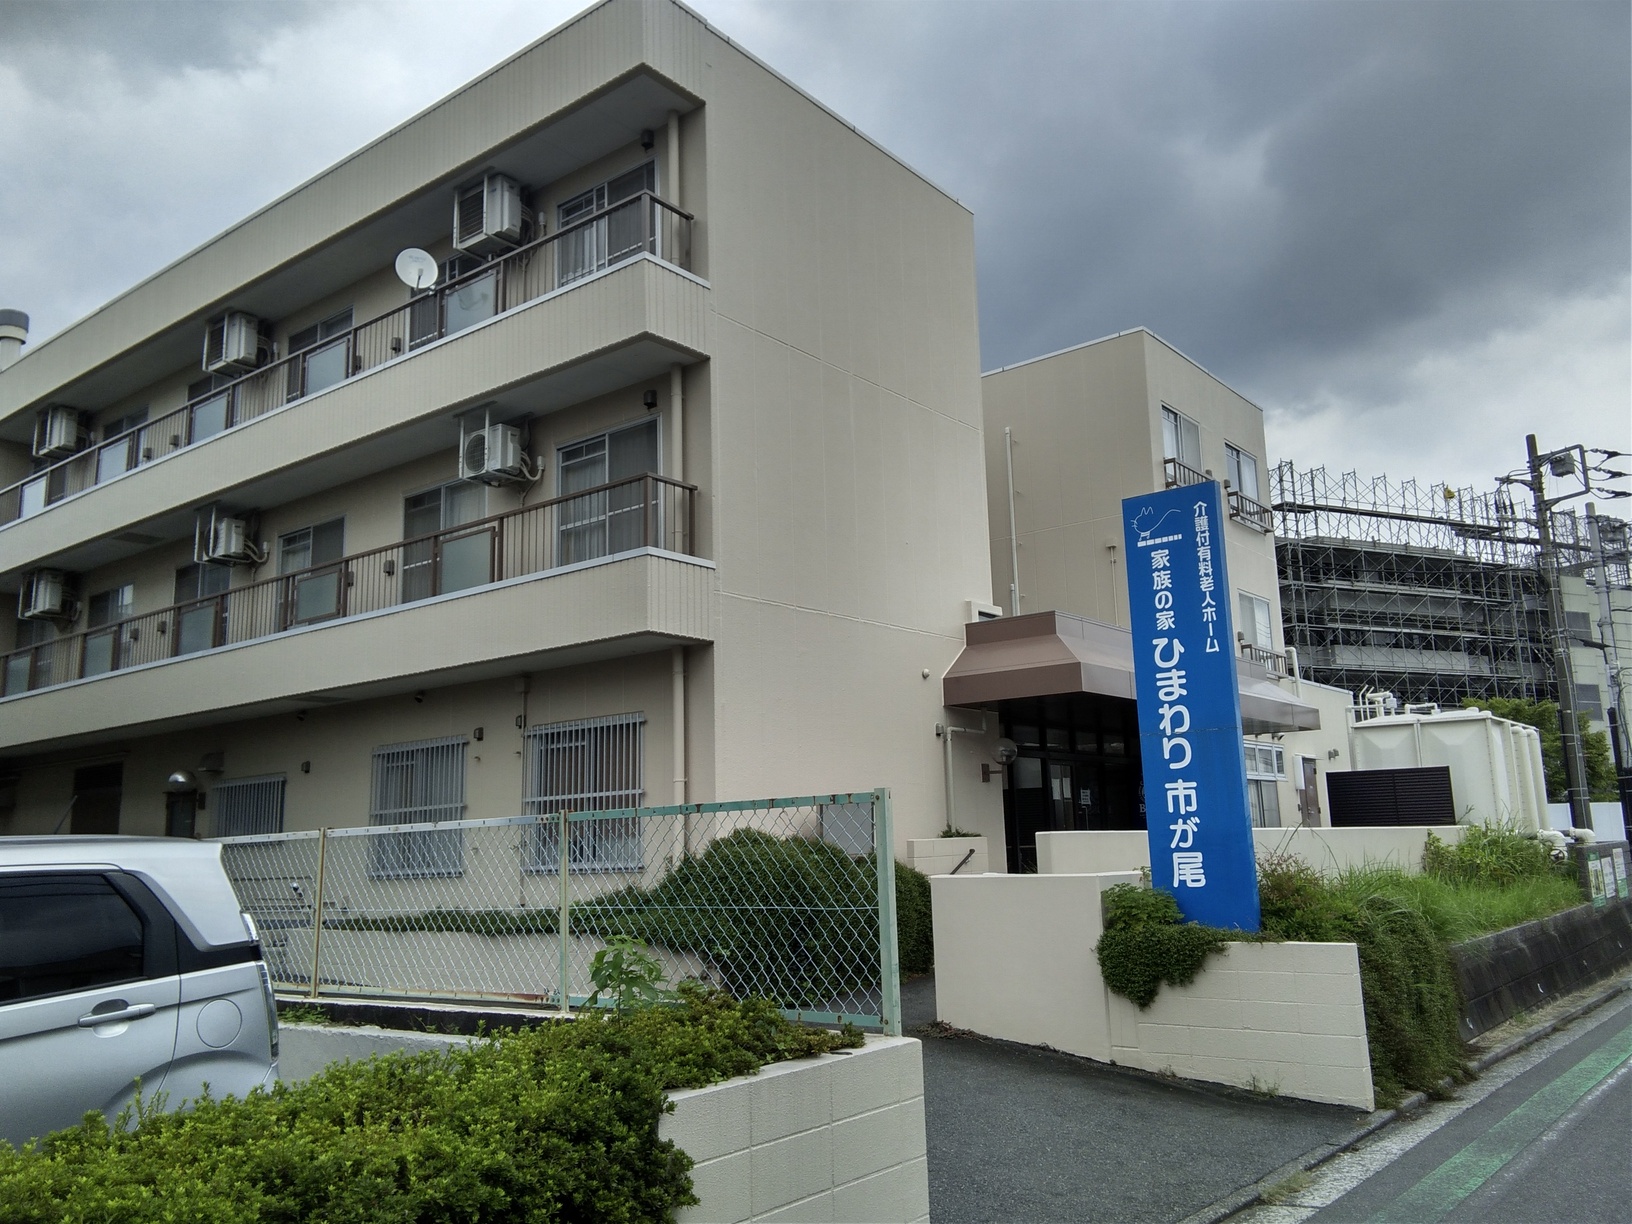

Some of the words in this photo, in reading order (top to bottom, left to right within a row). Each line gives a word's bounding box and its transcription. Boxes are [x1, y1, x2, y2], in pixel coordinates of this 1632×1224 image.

[1151, 549, 1175, 631] 家族の家
[1193, 501, 1219, 652] 介護付有料老人ホーム
[1152, 637, 1192, 769] ひまわり
[1165, 779, 1206, 888] 市が尾
